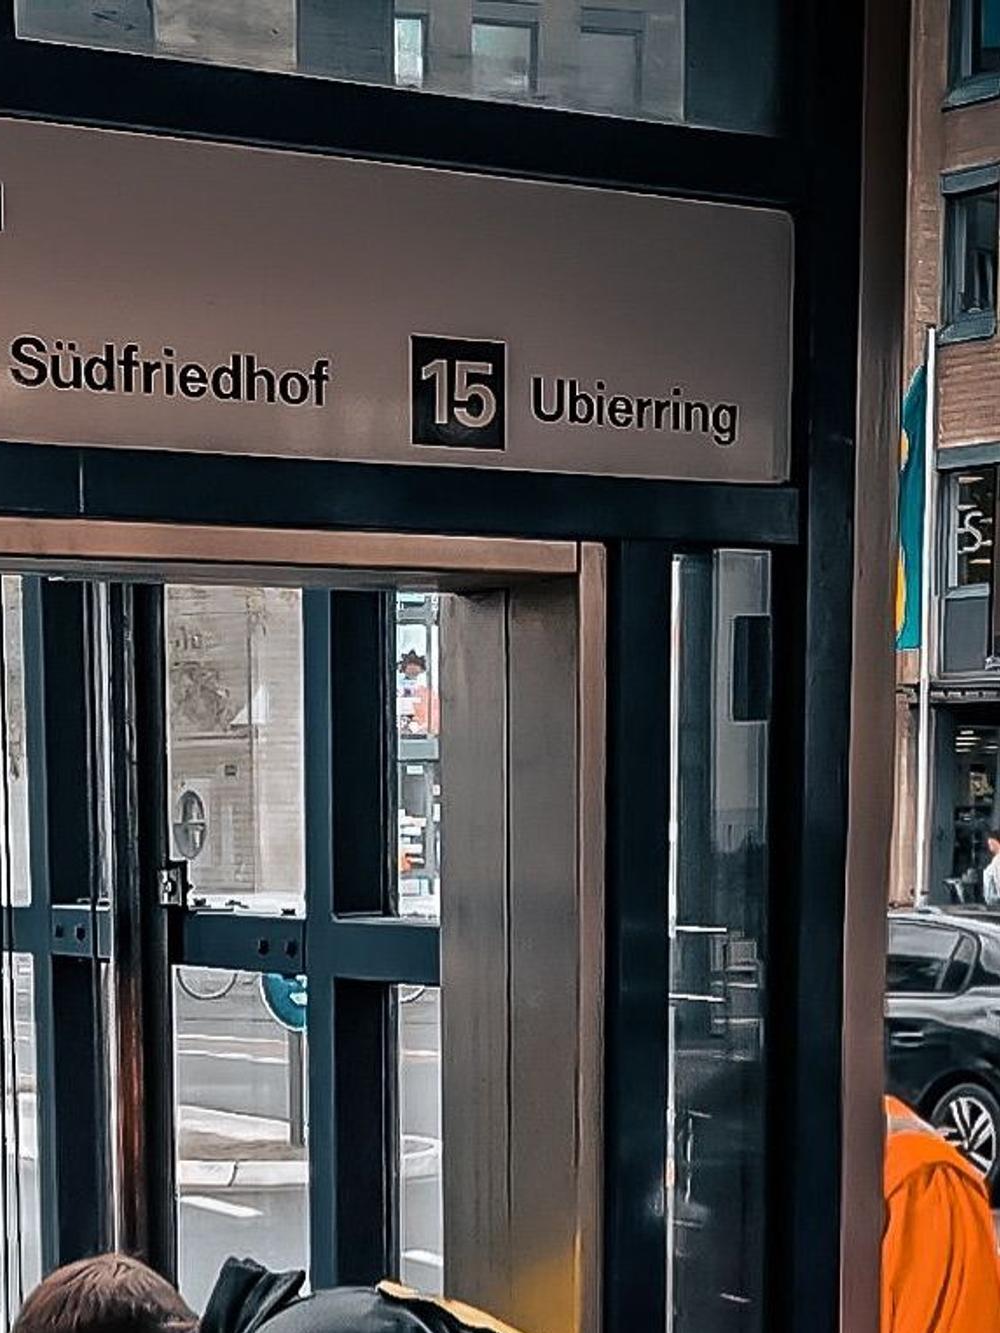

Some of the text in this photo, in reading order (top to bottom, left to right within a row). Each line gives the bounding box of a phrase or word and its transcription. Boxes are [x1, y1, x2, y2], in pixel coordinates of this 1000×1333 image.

[9, 335, 331, 407] Südfriedhof
[420, 358, 738, 446] 15 Ubierring
